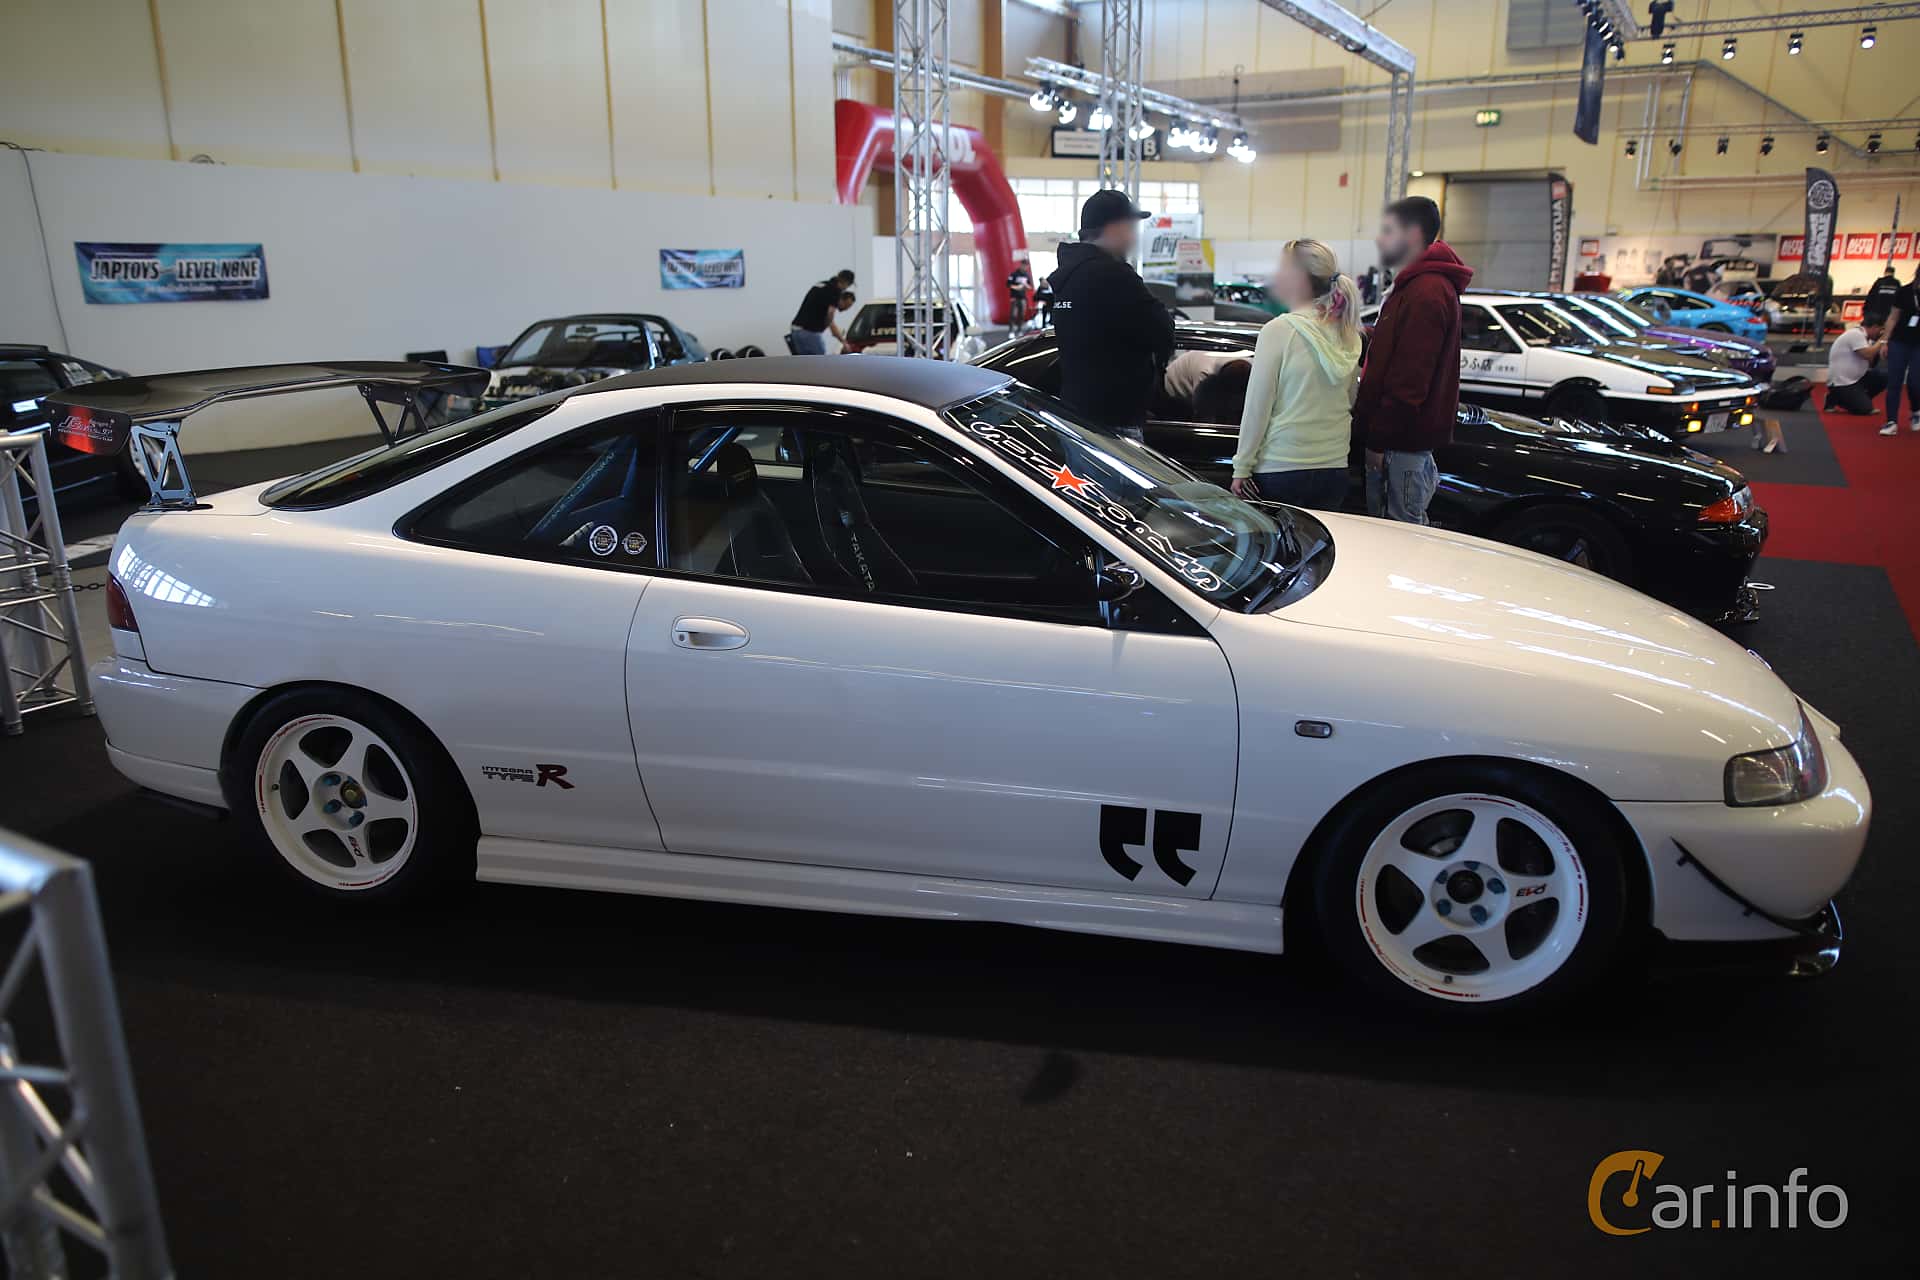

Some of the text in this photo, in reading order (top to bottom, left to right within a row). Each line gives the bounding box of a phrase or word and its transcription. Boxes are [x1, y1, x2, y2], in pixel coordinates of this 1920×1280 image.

[92, 259, 160, 281] JAPTOYS
[177, 259, 216, 280] LEVEL
[871, 327, 897, 336] LEVE
[483, 764, 575, 789] TYPE R
